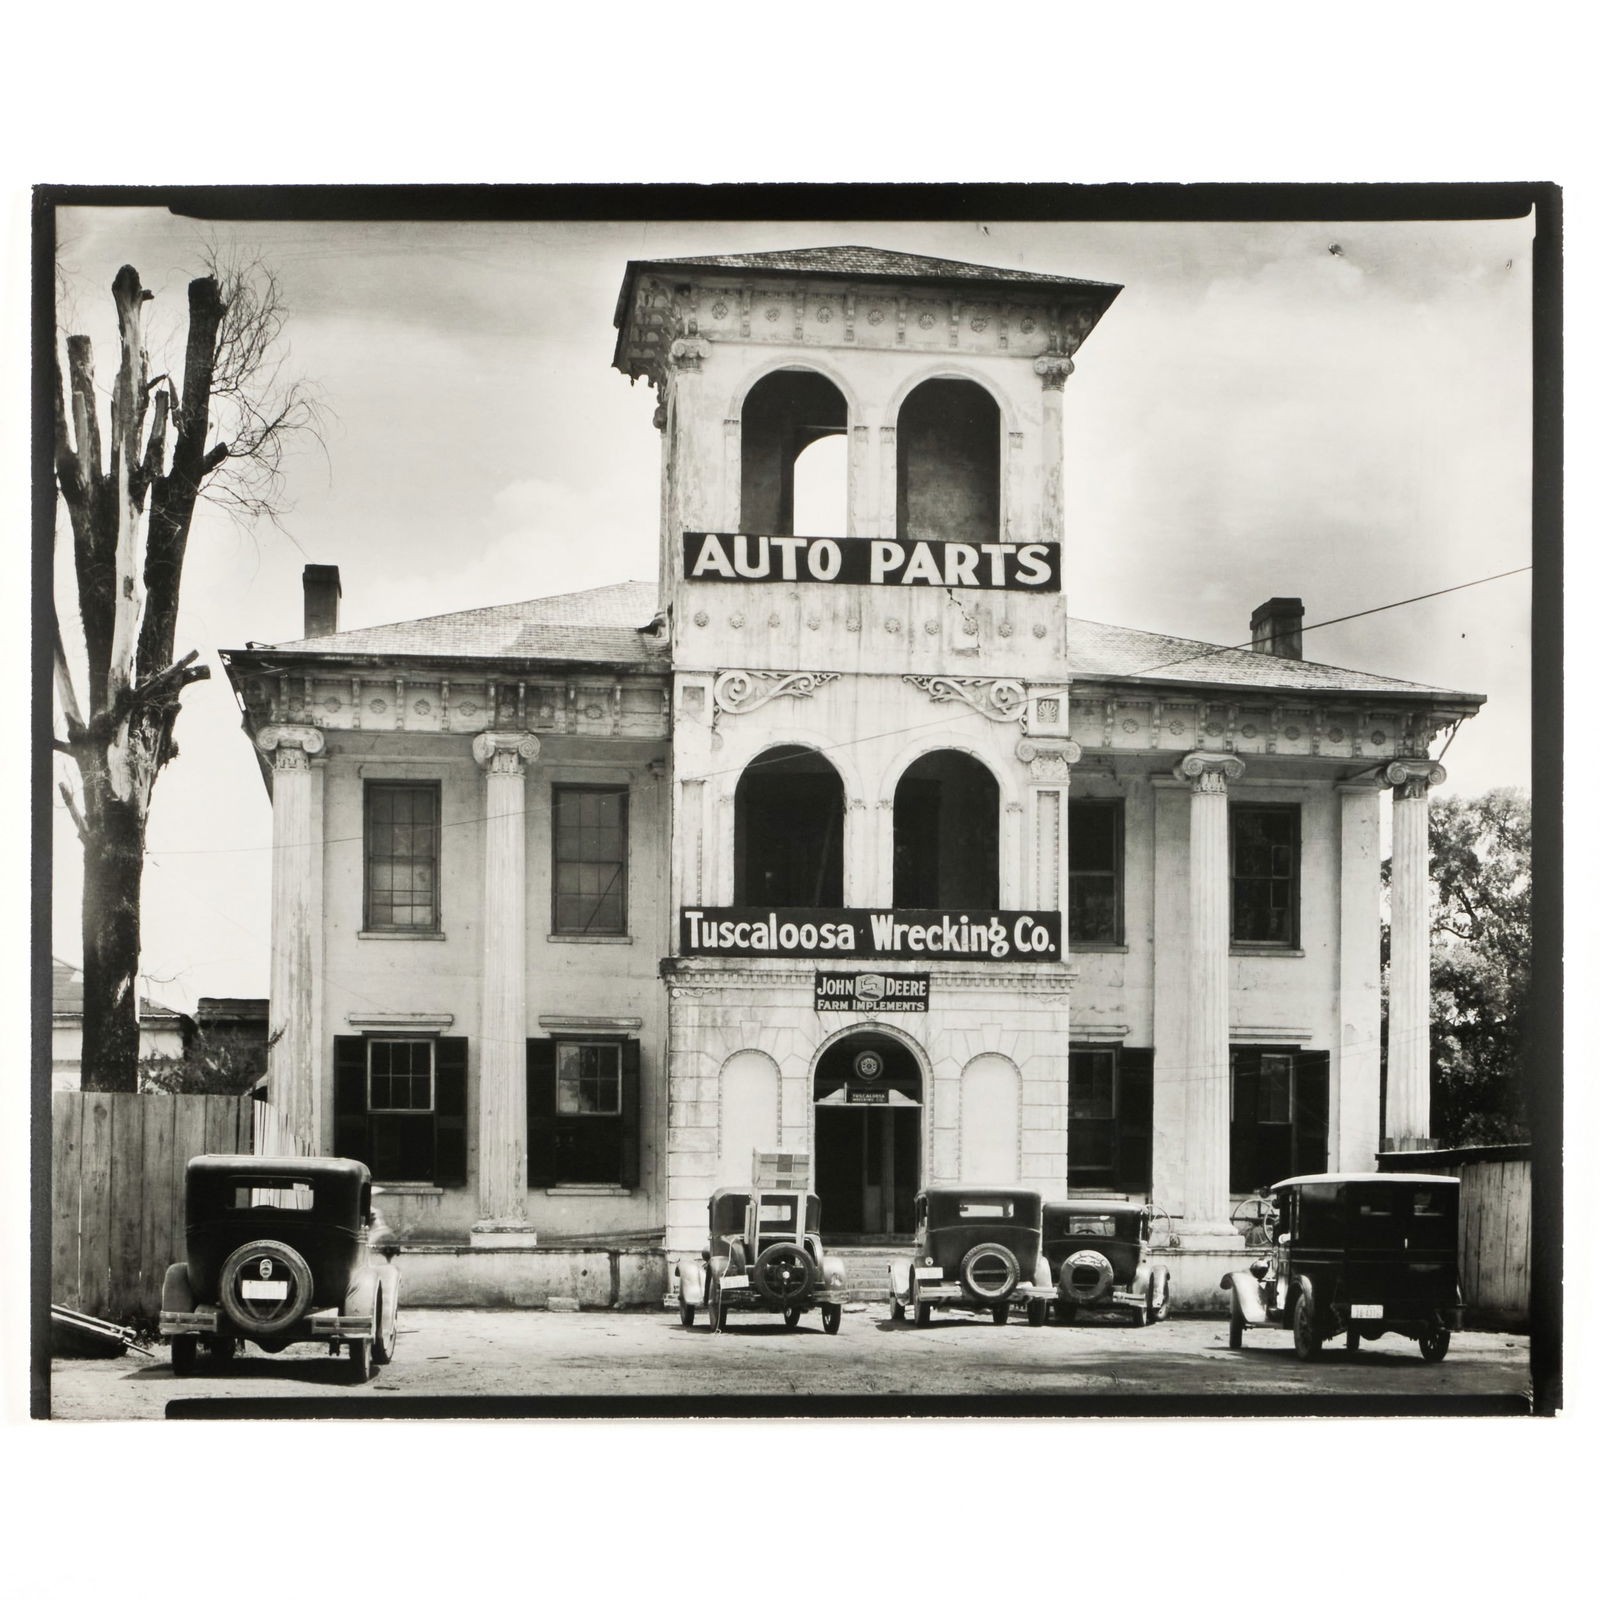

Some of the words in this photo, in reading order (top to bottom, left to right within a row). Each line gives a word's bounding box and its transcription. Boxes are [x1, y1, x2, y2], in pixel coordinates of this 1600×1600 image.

[692, 534, 842, 581] AUTO
[870, 540, 1052, 586] PARTS
[685, 912, 855, 950] Tuscaloosa
[870, 914, 1009, 957] Wrecking
[1014, 916, 1056, 952] Co.
[817, 977, 854, 995] JOHN
[886, 978, 927, 996] DEERE
[817, 1000, 849, 1010] FARM
[852, 999, 925, 1011] IMPLEMENTS
